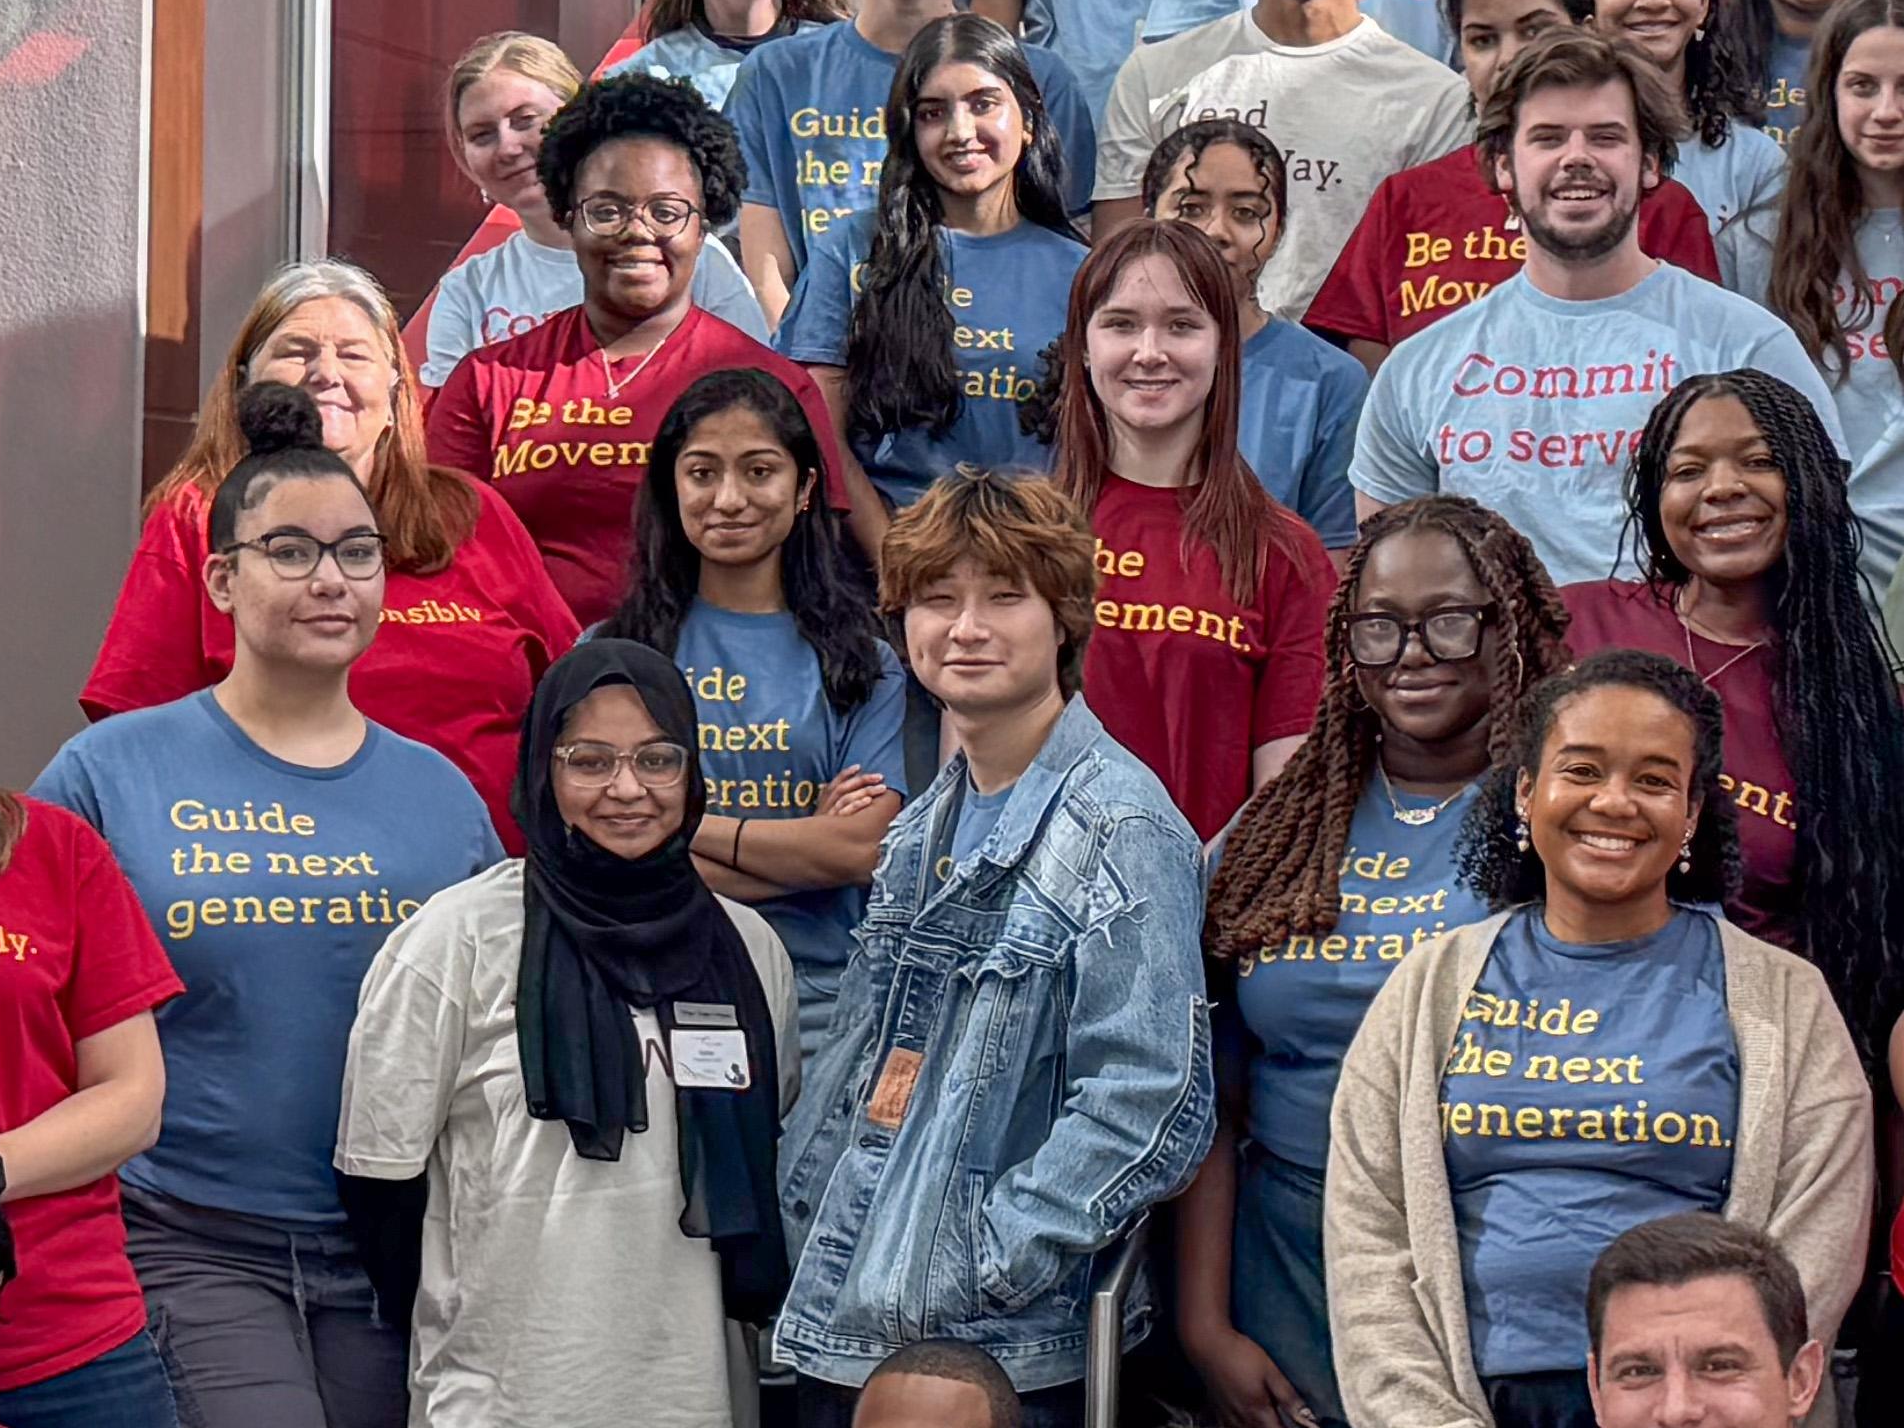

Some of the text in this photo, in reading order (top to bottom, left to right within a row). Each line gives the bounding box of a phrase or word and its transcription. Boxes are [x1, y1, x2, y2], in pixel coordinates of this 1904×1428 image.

[790, 107, 887, 140] Guid
[1405, 226, 1528, 268] Be the
[953, 325, 1014, 351] ext
[1452, 350, 1675, 399] Commit
[508, 397, 633, 430] Be the
[493, 438, 653, 479] Movem
[1438, 424, 1492, 465] to
[1096, 598, 1251, 652] ement.
[698, 717, 791, 752] next
[170, 799, 316, 837] Guide
[171, 843, 380, 876] the next
[167, 889, 423, 939] generatio
[1340, 889, 1449, 914] next
[1462, 989, 1600, 1036] Guide
[1524, 1054, 1644, 1085] next
